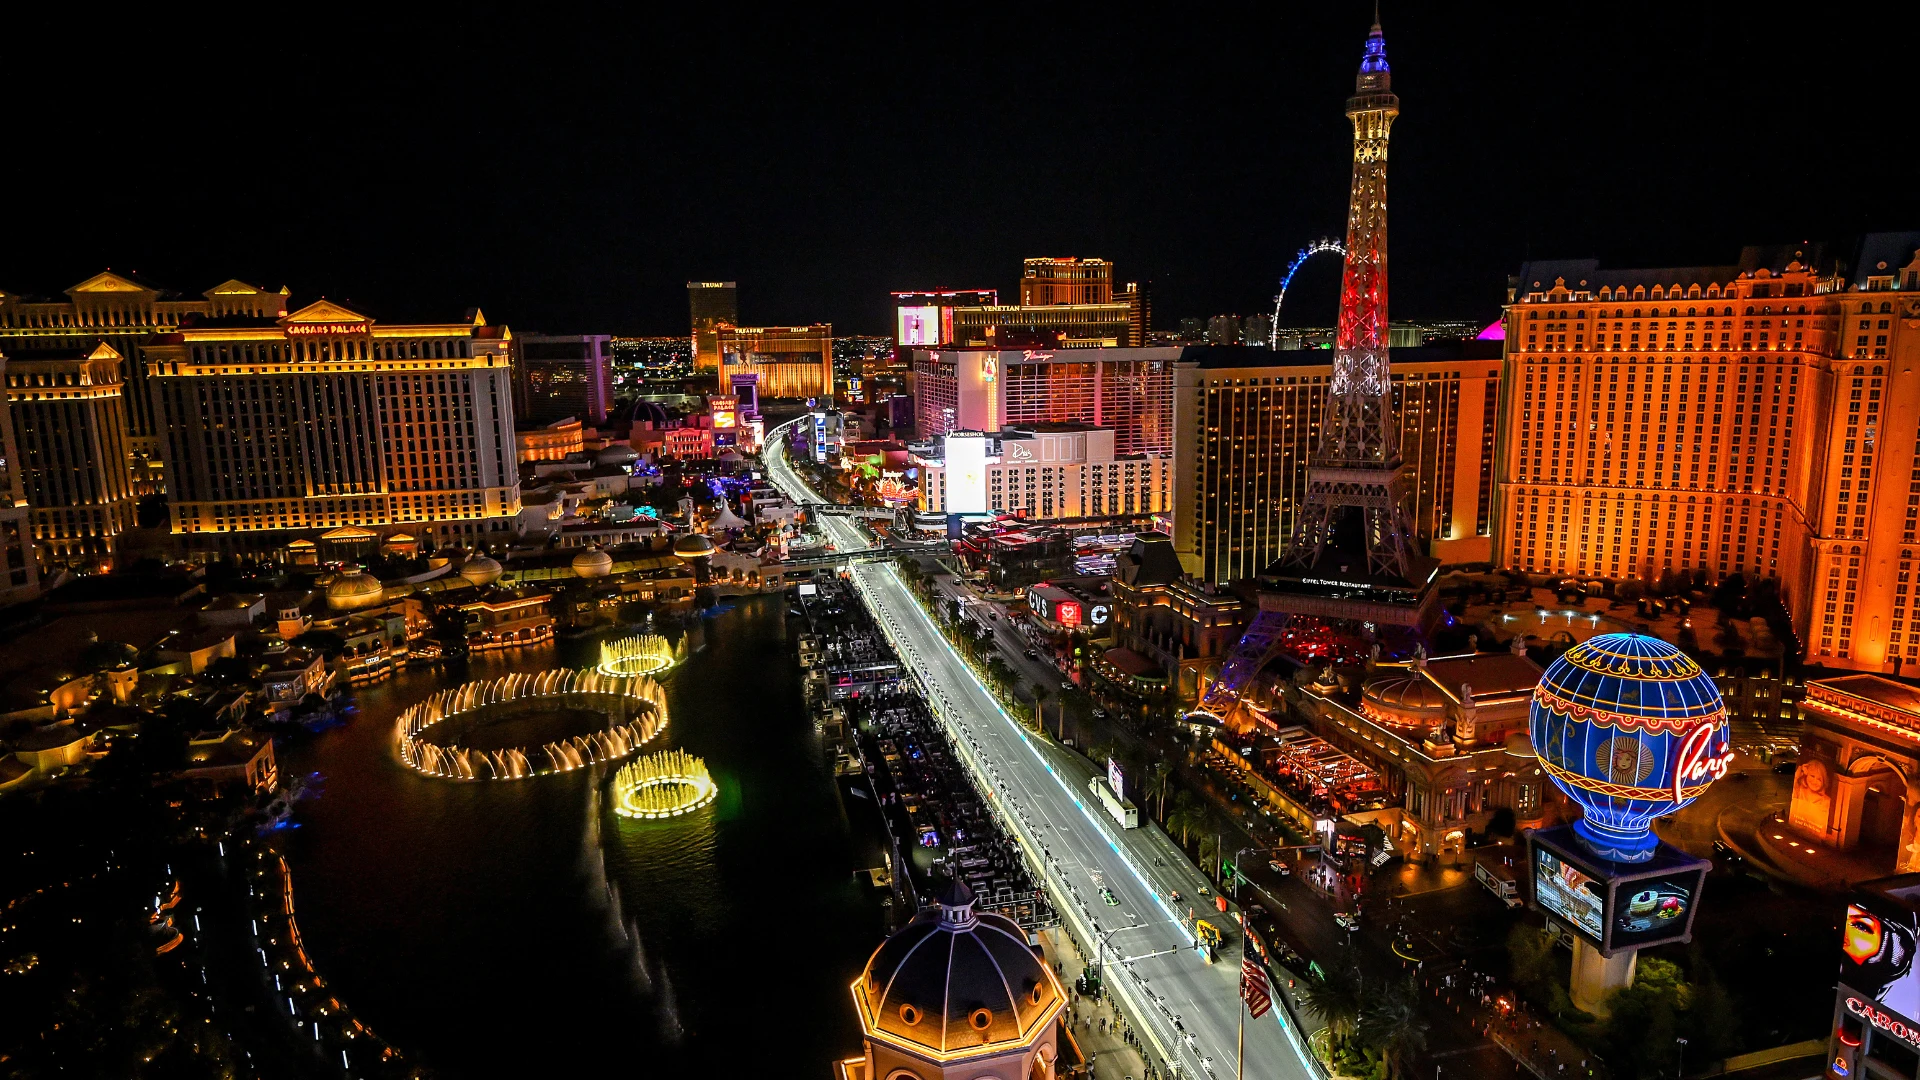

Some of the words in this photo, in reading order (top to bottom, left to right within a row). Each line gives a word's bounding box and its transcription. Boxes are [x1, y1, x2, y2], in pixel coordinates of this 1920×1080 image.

[287, 325, 329, 335] CAESARS
[330, 324, 367, 334] PALACE
[1340, 581, 1371, 589] RESTAURANT
[1028, 590, 1048, 618] CVS
[1675, 722, 1735, 805] Paris
